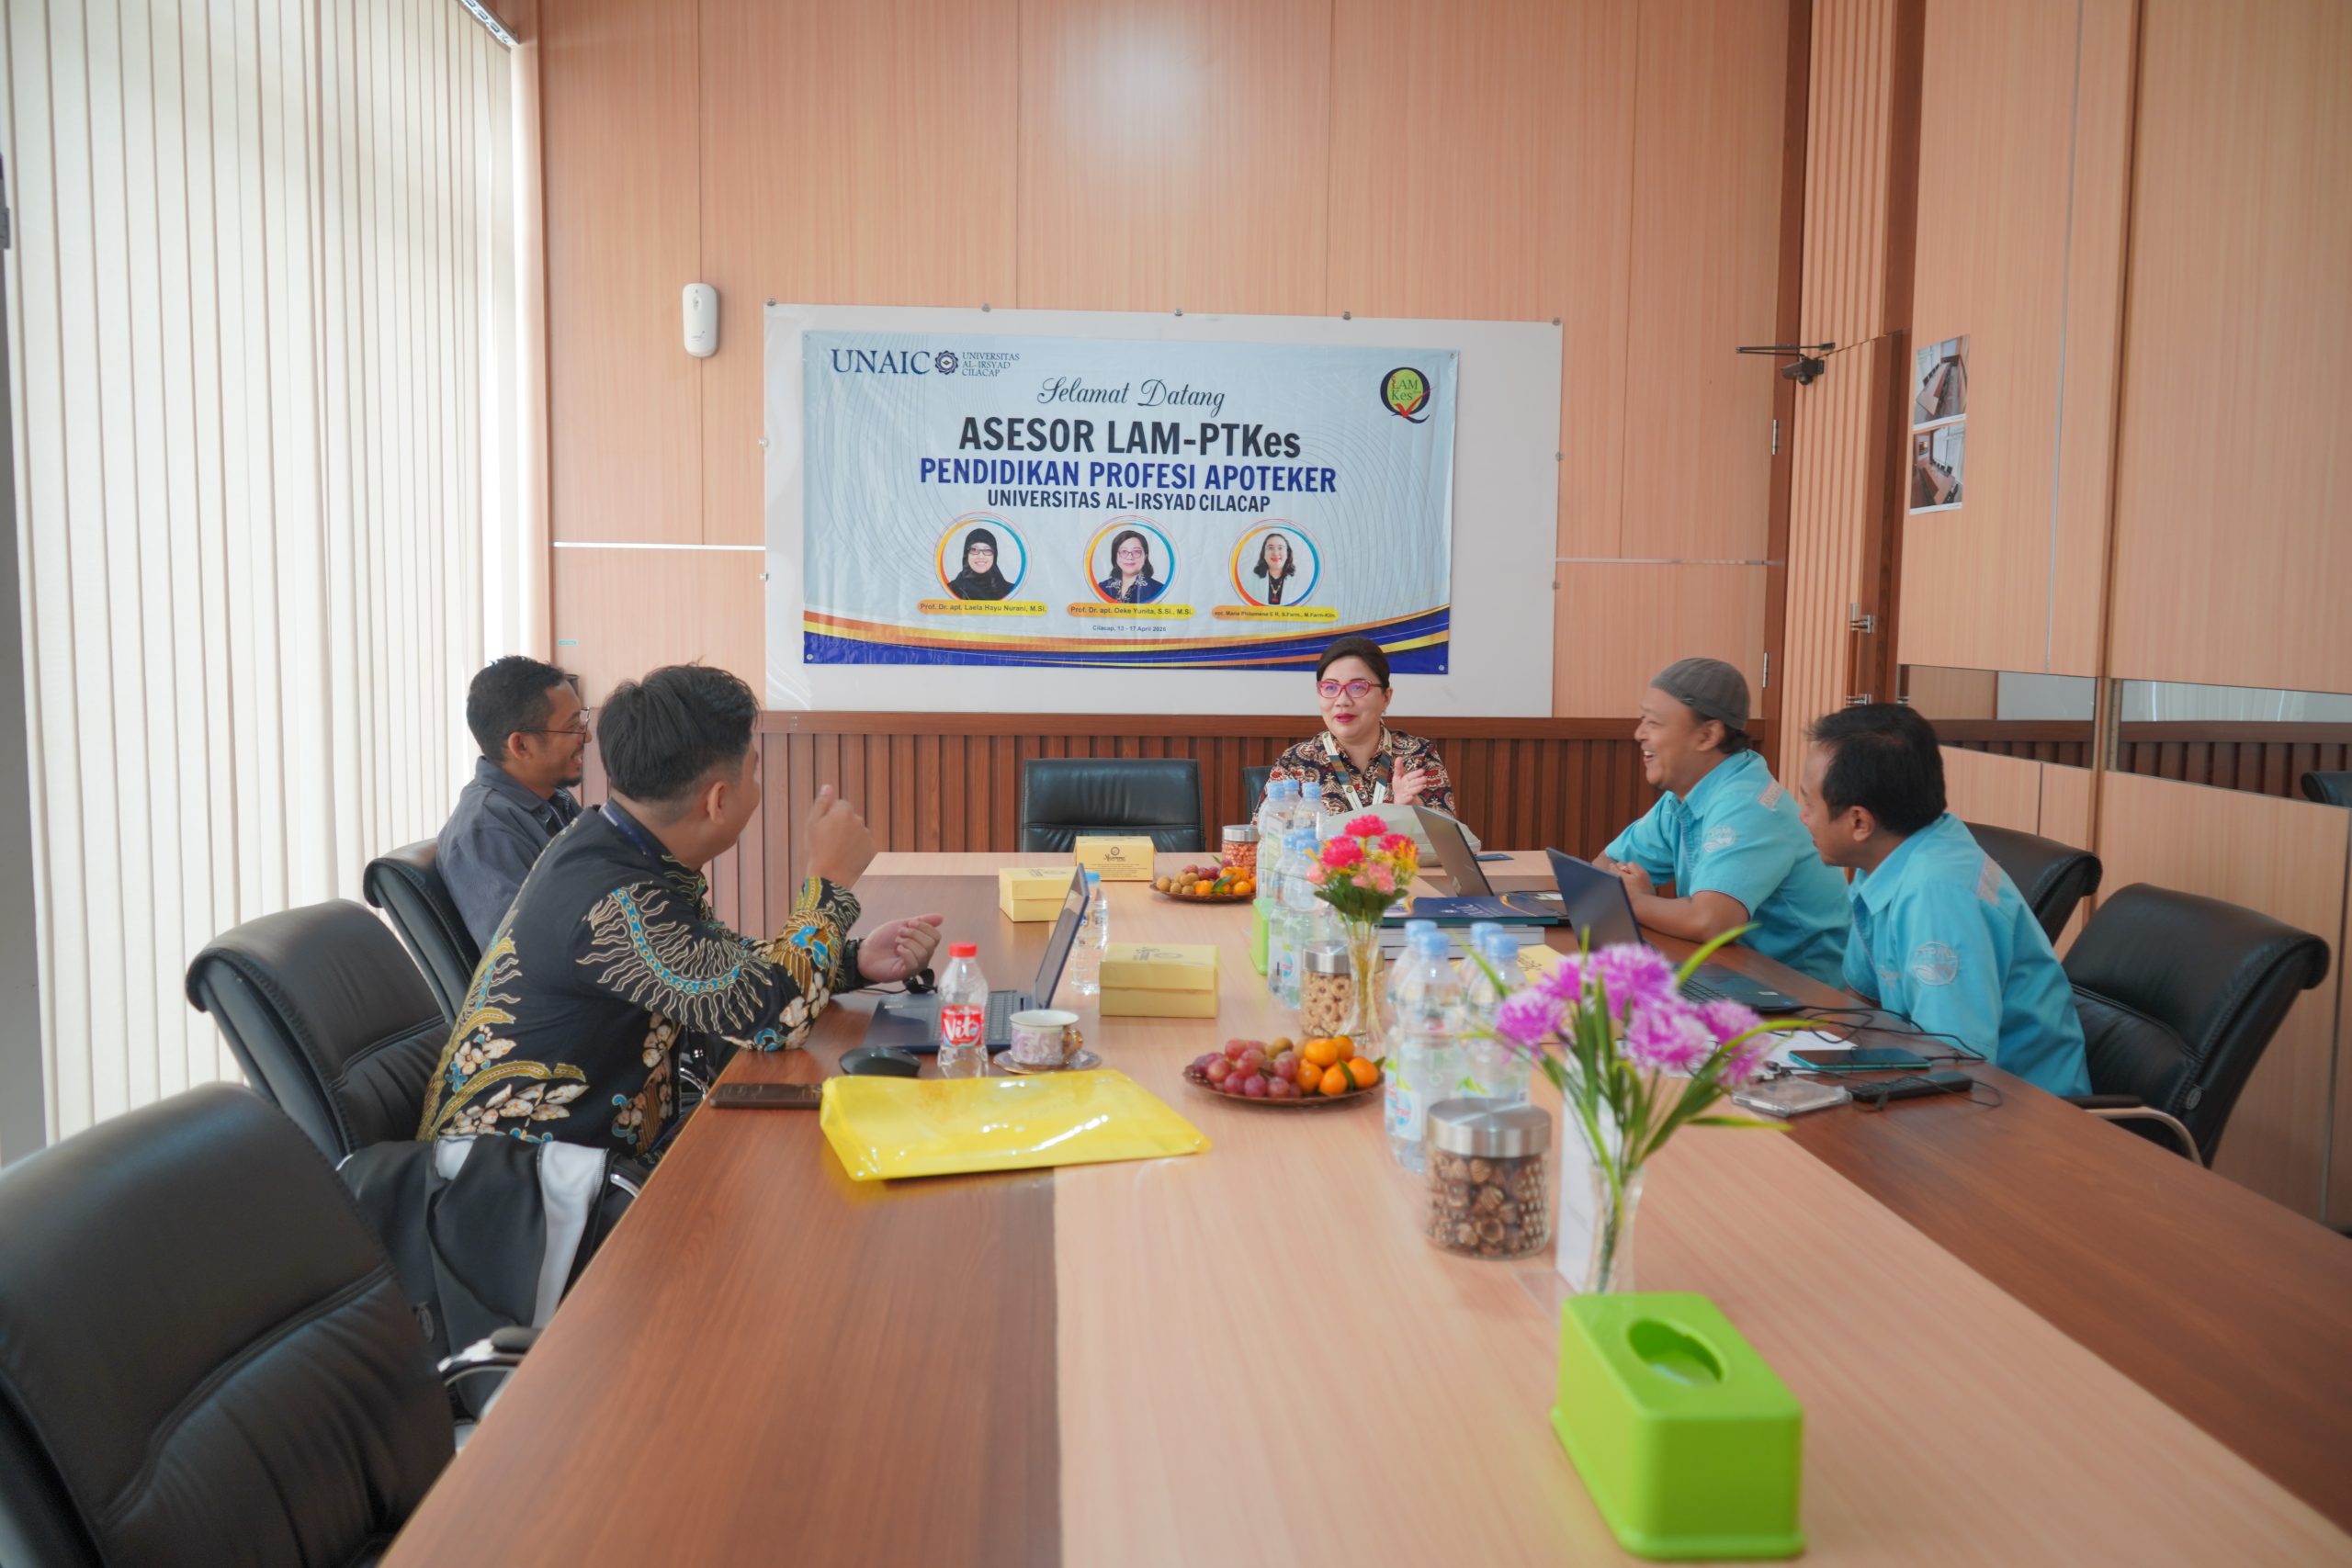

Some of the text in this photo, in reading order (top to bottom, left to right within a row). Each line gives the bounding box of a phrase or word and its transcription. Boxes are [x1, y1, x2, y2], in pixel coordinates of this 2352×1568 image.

[831, 348, 931, 376] UNAIC
[962, 352, 1020, 361] UNIVERSITAS
[962, 360, 1011, 368] AL-IRSYAD
[962, 368, 1001, 378] CILACAP
[1036, 376, 1226, 418] Selamat Datang
[958, 416, 1301, 458] ASESOR LAM-PTKes
[920, 457, 1337, 493] PENDIDIKAN PROFESI APOTEKER
[988, 489, 1271, 513] UNIVERSITAS AL-IRSYAD CILACAP
[984, 604, 1002, 613] Hayu
